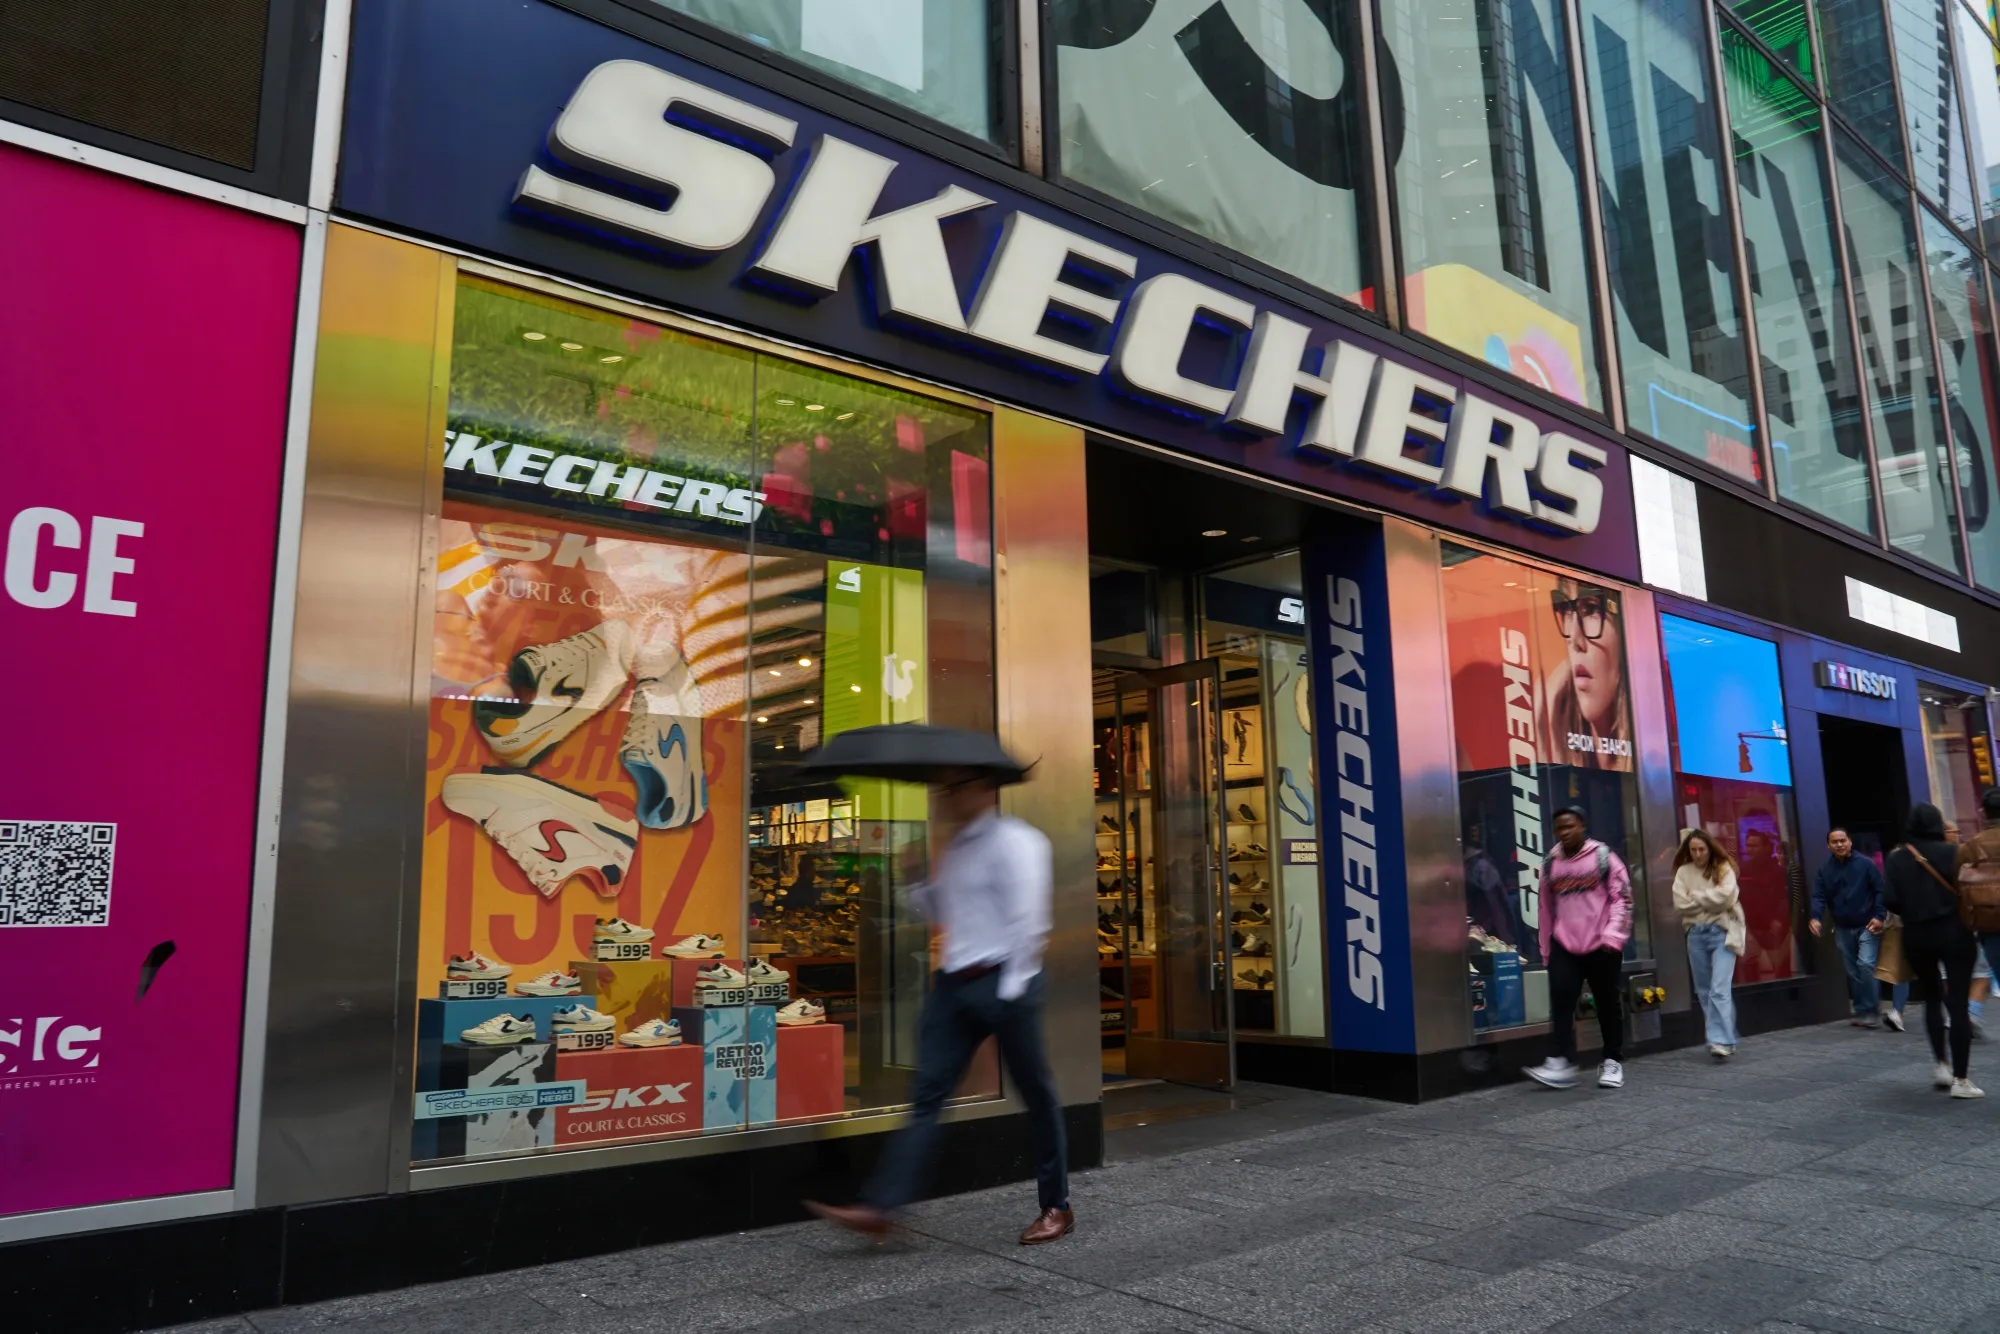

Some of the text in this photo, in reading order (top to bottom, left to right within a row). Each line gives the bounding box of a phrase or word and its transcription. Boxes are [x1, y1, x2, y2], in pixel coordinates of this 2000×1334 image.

[520, 60, 1608, 534] SKECHERS
[444, 430, 767, 524] KECHERS
[559, 587, 576, 605] &
[1849, 666, 1897, 700] TISSOT
[1500, 626, 1543, 930] SKECHERS
[1327, 573, 1385, 1011] SKECHERS
[616, 944, 651, 957] 1992
[468, 981, 508, 996] 1992
[758, 984, 789, 998] 1992
[577, 1032, 615, 1048] 1992
[716, 1043, 763, 1059] RETRO
[716, 1056, 765, 1069] REVIVAL
[735, 1066, 765, 1079] 1992
[49, 1077, 97, 1087] RETAIL
[435, 1097, 503, 1111] SKECHERS
[539, 1093, 573, 1104] HERE!
[568, 1081, 692, 1114] SKX
[568, 1112, 686, 1135] COURT & CLASSICS
